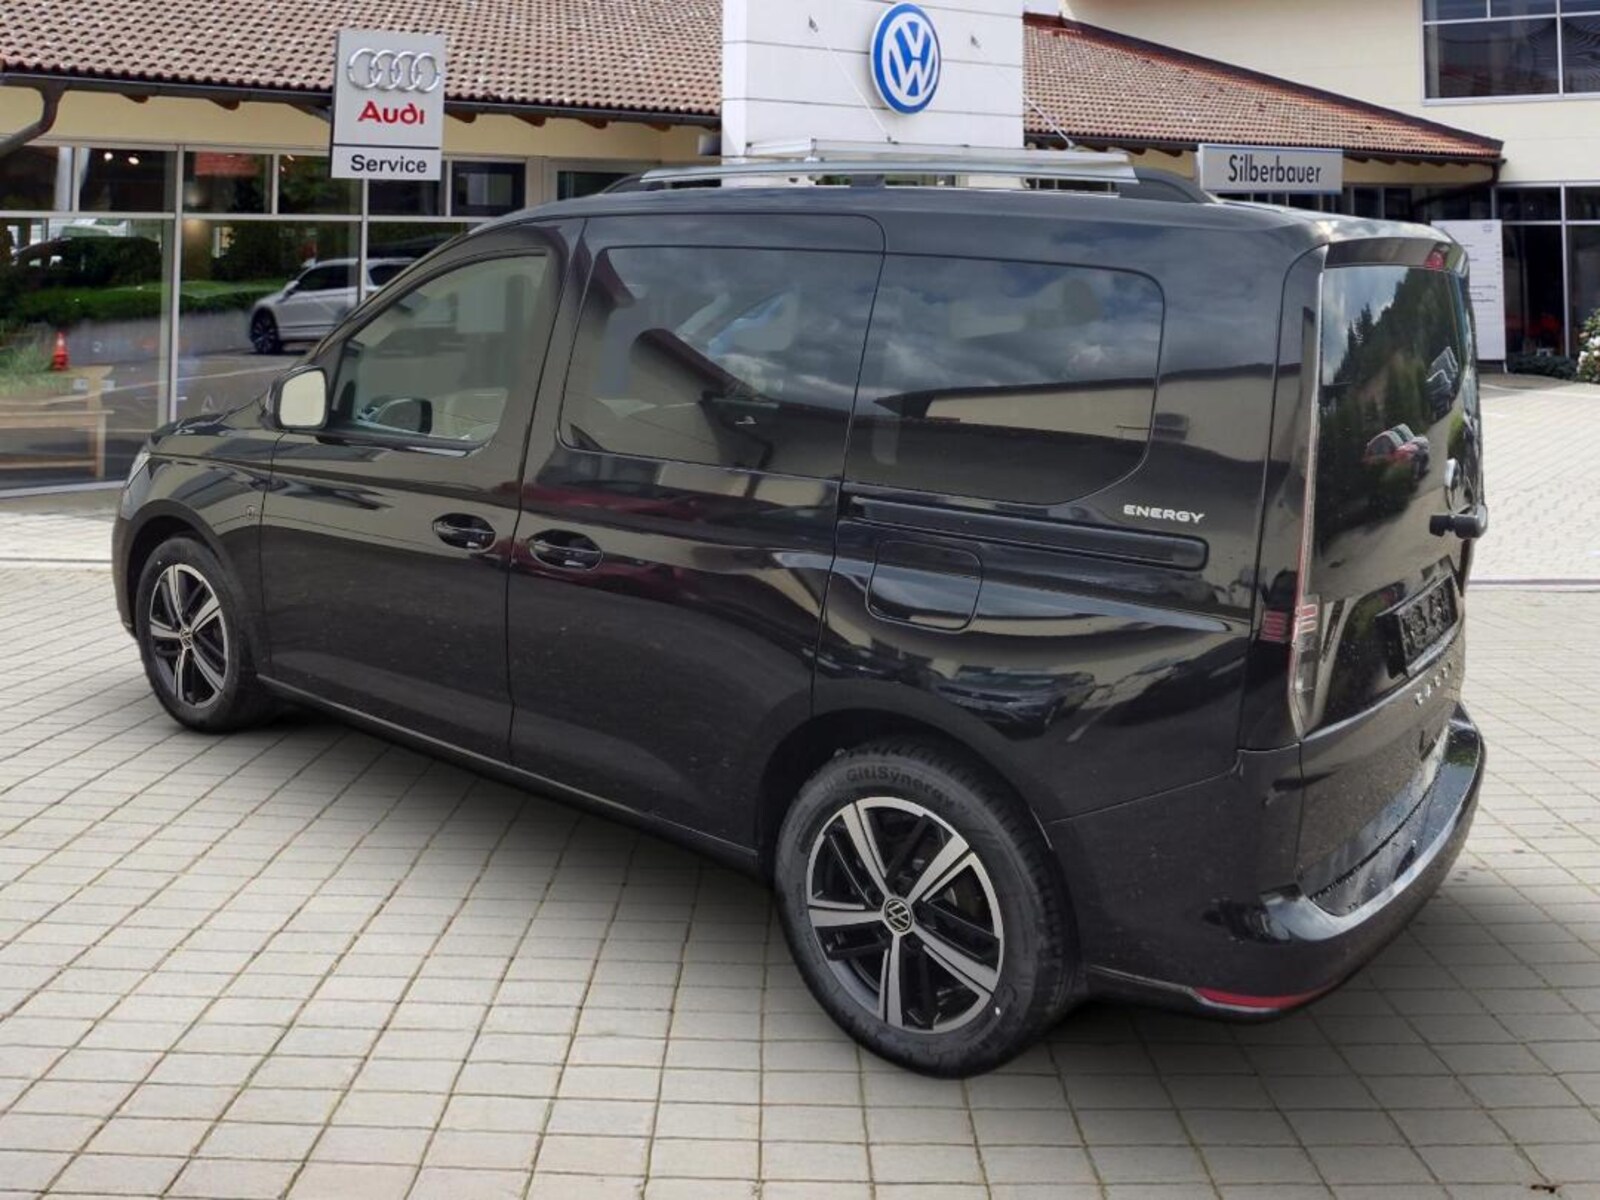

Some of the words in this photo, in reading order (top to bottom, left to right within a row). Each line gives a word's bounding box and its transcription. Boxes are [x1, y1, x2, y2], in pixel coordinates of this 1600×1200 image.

[880, 10, 939, 108] VW
[358, 101, 424, 124] Audi
[351, 154, 427, 173] Service
[1228, 154, 1321, 183] Silberbauer
[1123, 504, 1205, 523] ENERGY
